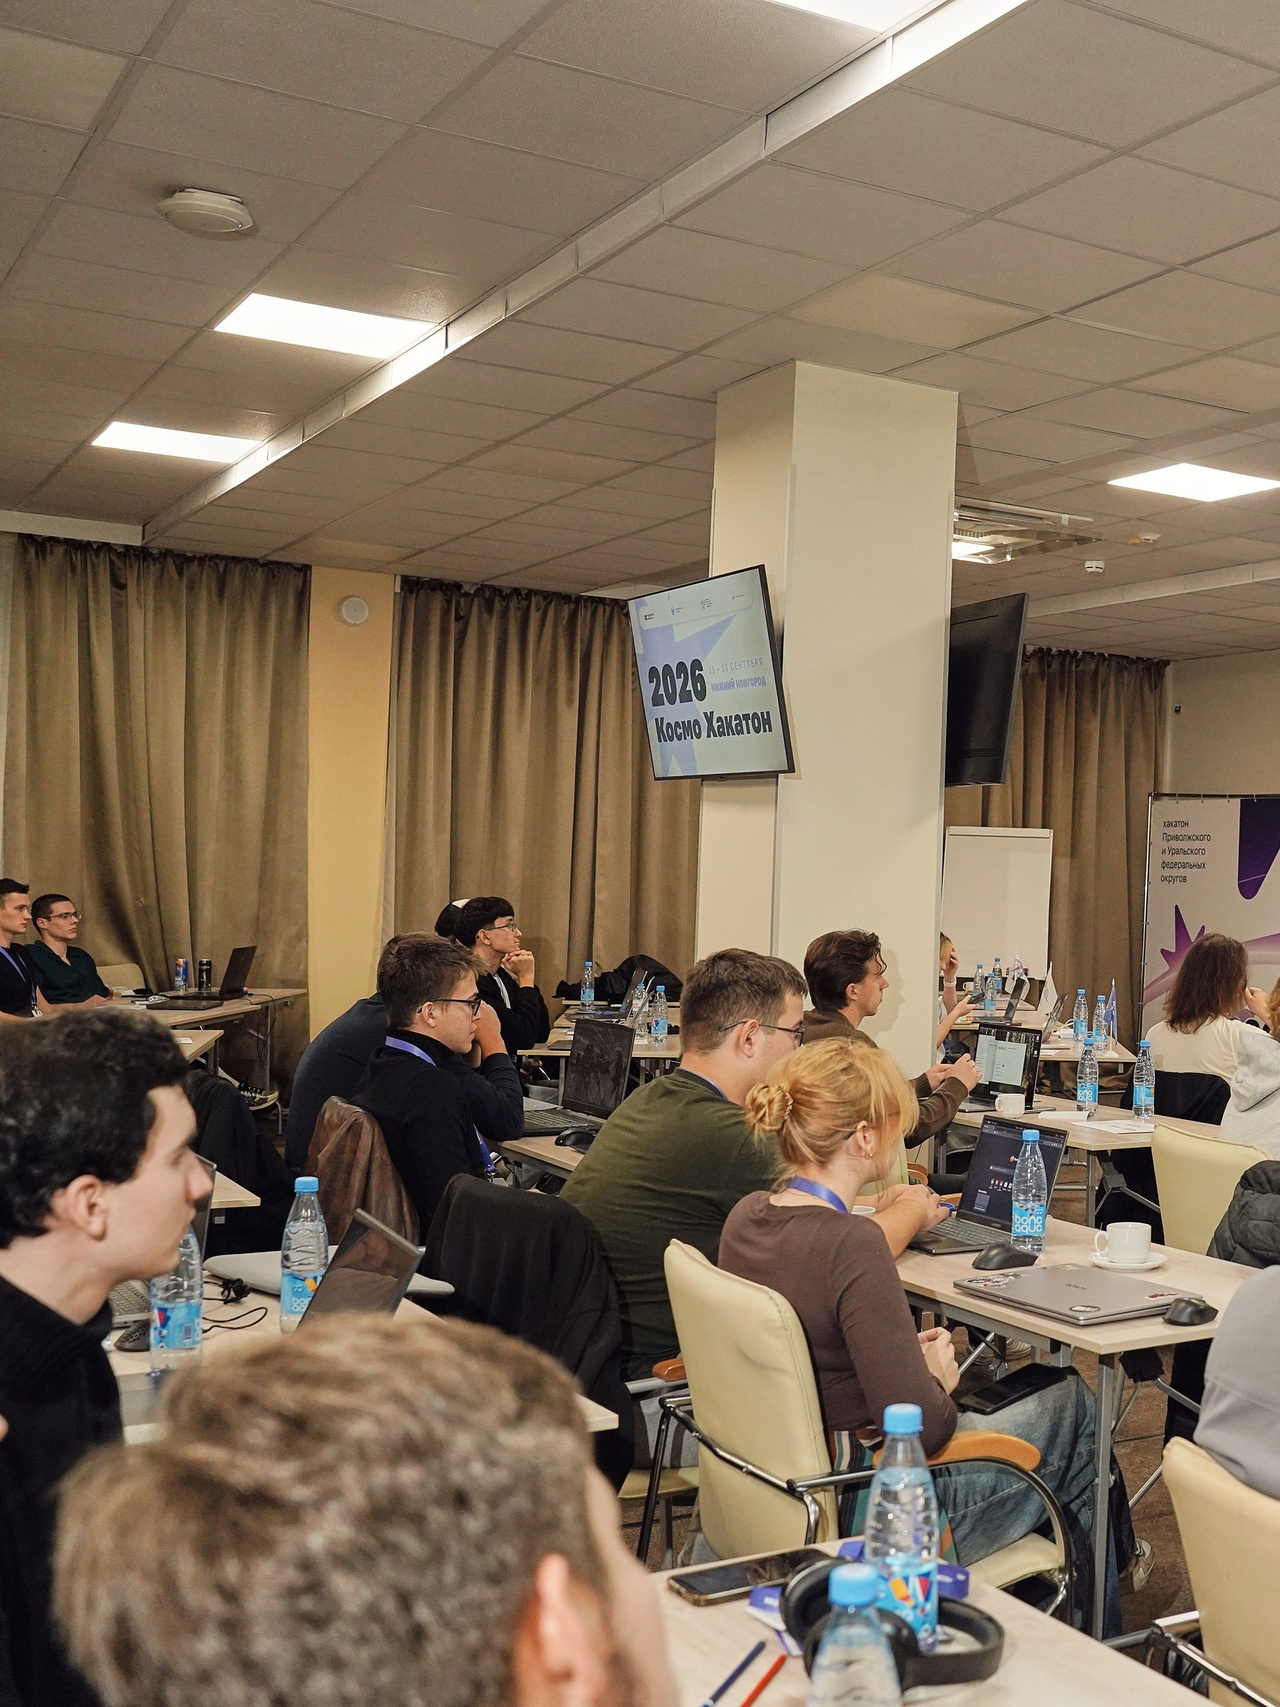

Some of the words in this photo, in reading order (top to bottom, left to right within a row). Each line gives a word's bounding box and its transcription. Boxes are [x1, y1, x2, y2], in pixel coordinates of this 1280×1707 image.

[730, 657, 764, 672] СЕНТЯБРЯ
[648, 658, 707, 707] 2026
[735, 675, 767, 690] НОВГОРОД
[654, 717, 702, 743] Космо
[703, 711, 773, 738] Хакатон
[1162, 820, 1189, 828] хакатон
[1162, 832, 1212, 843] Приволжского
[1167, 846, 1206, 857] Уральского
[1160, 860, 1207, 871] федеральных
[1160, 874, 1187, 884] округов
